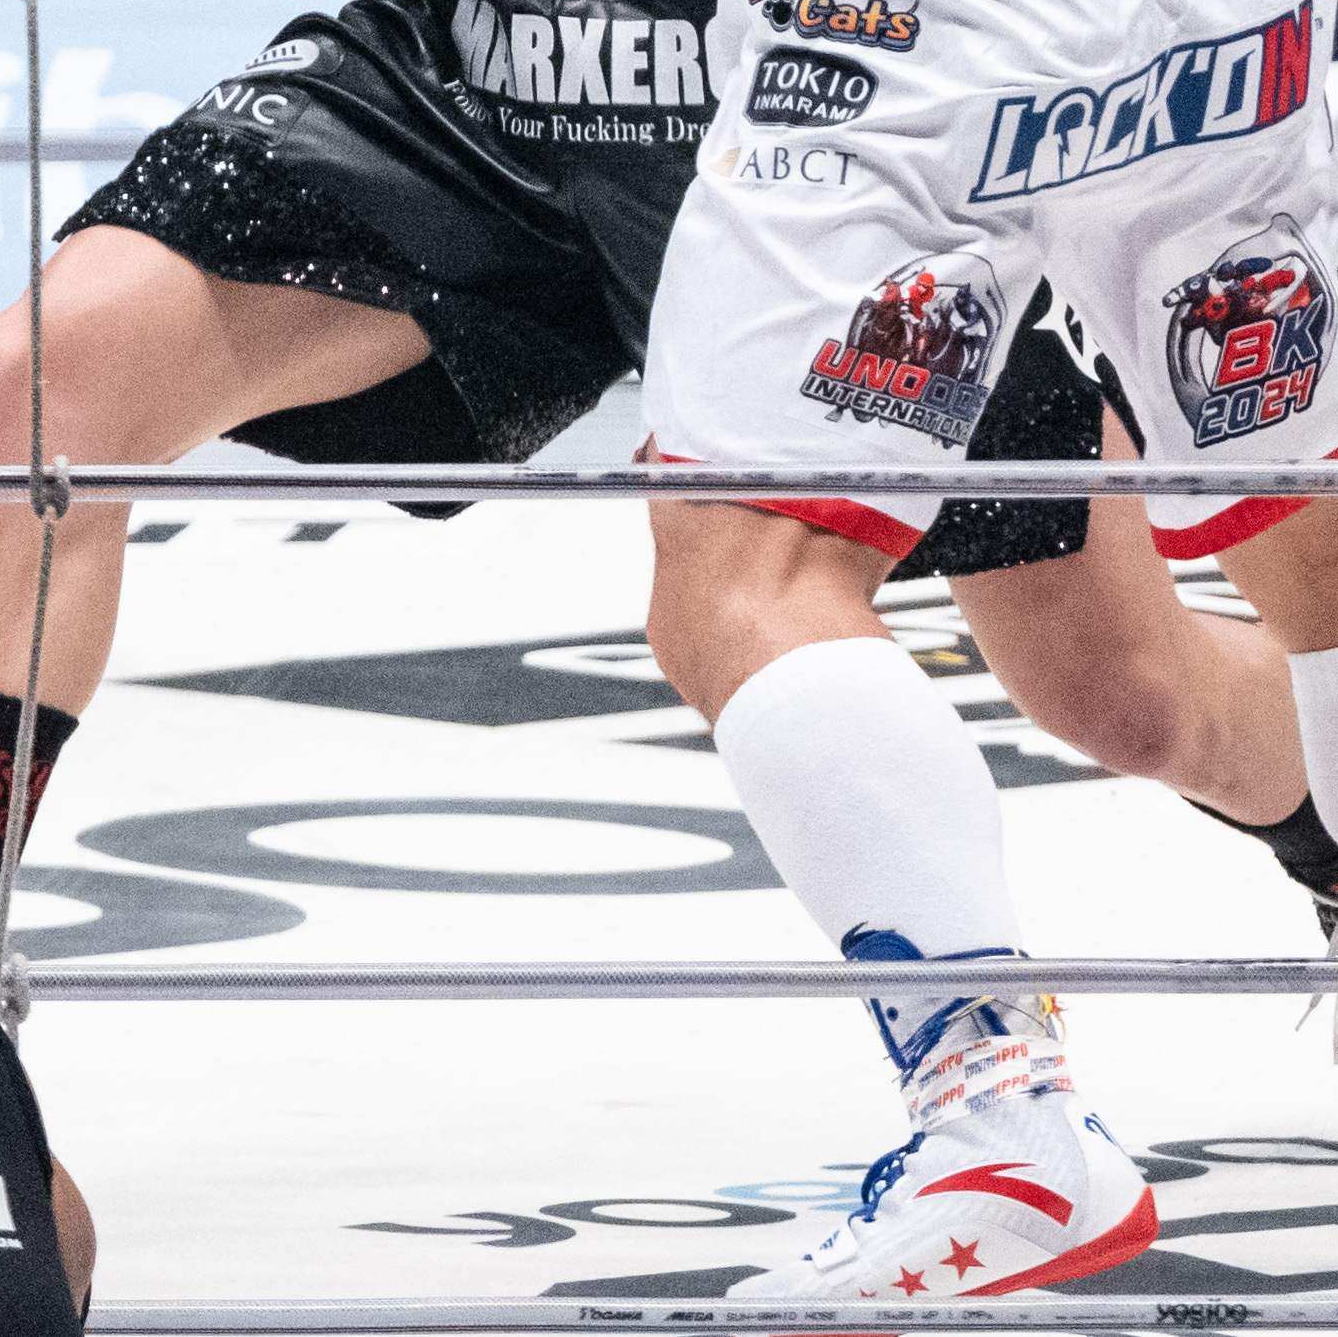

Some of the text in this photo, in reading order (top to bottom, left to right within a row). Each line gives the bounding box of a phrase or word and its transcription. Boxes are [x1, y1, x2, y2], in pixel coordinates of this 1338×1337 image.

[762, 62, 870, 103] TOKIO
[498, 108, 545, 140] Your
[551, 115, 655, 146] Fucking
[753, 93, 859, 121] INKARAMI
[739, 146, 859, 186] ABCT
[1211, 293, 1324, 392] BK
[1195, 363, 1318, 445] 2024
